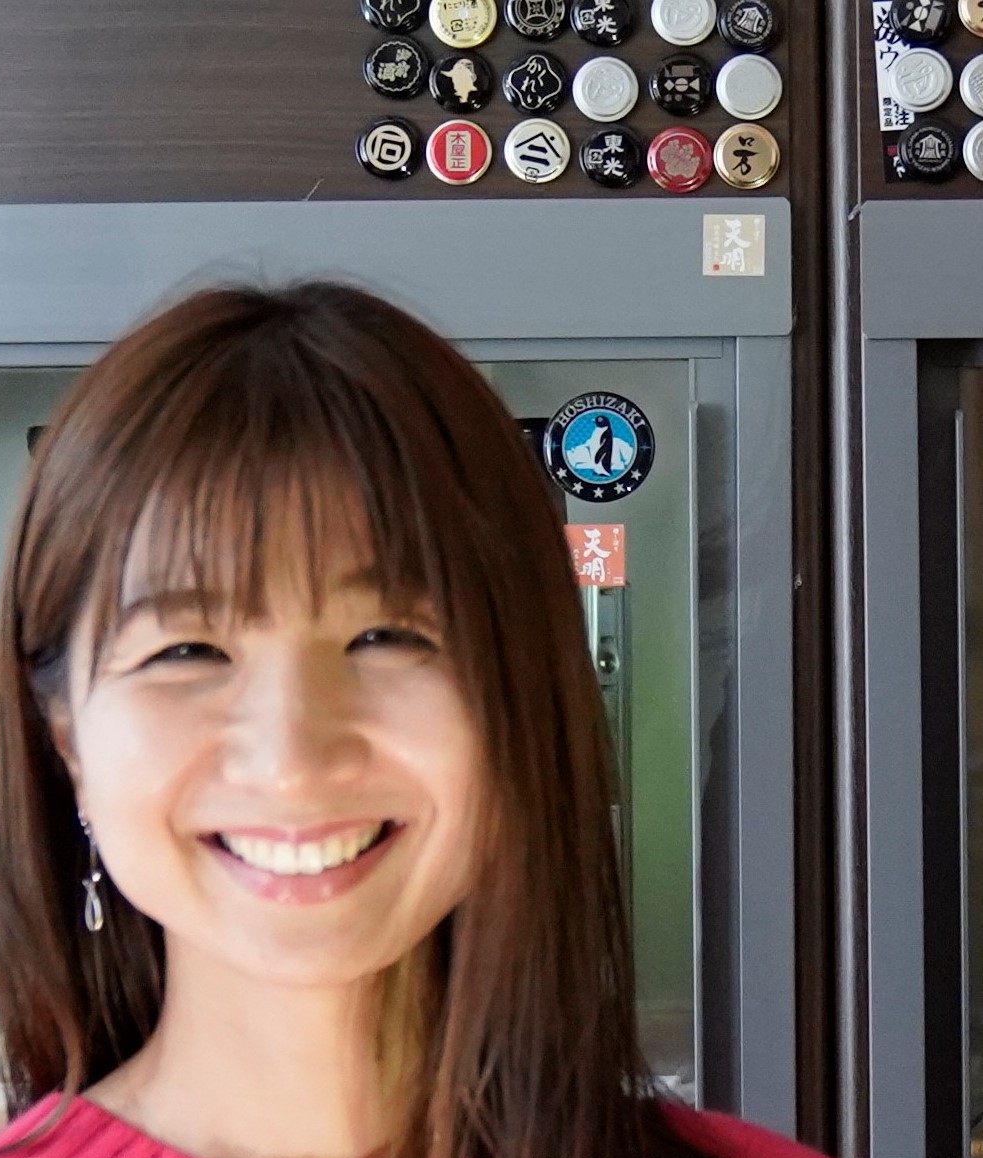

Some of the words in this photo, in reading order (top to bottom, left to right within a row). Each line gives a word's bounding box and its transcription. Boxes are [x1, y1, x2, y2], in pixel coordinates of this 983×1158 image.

[603, 134, 625, 177] 東光
[719, 218, 751, 273] 天明
[556, 395, 646, 429] HOSHIZAKI
[579, 528, 611, 583] 天明
